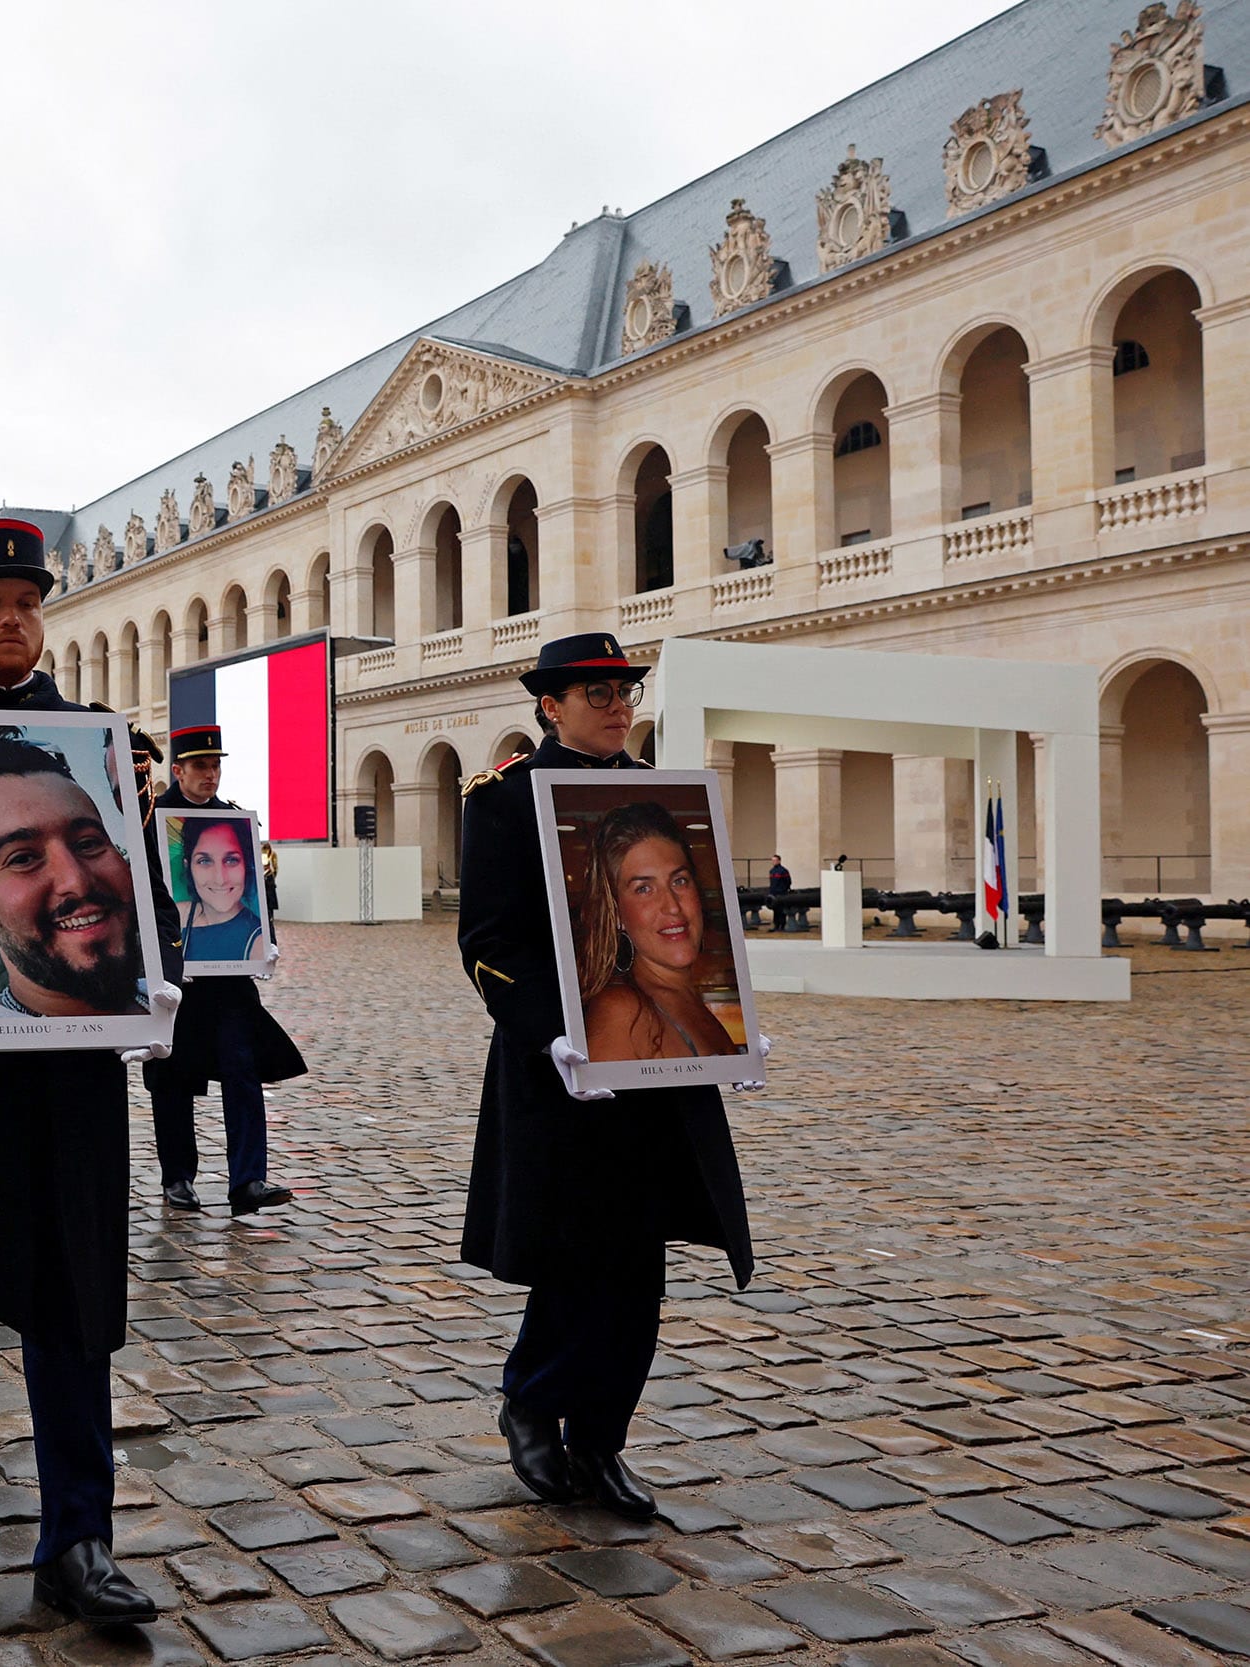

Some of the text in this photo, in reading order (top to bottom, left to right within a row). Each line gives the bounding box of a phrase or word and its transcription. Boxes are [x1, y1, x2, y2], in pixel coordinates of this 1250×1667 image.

[404, 713, 479, 734] MUSÉE DE L'ARMÉE
[66, 1025, 77, 1033] 27
[81, 1024, 103, 1032] ANS
[641, 1066, 663, 1075] HILA
[674, 1065, 683, 1073] 41
[686, 1064, 703, 1072] ANS
